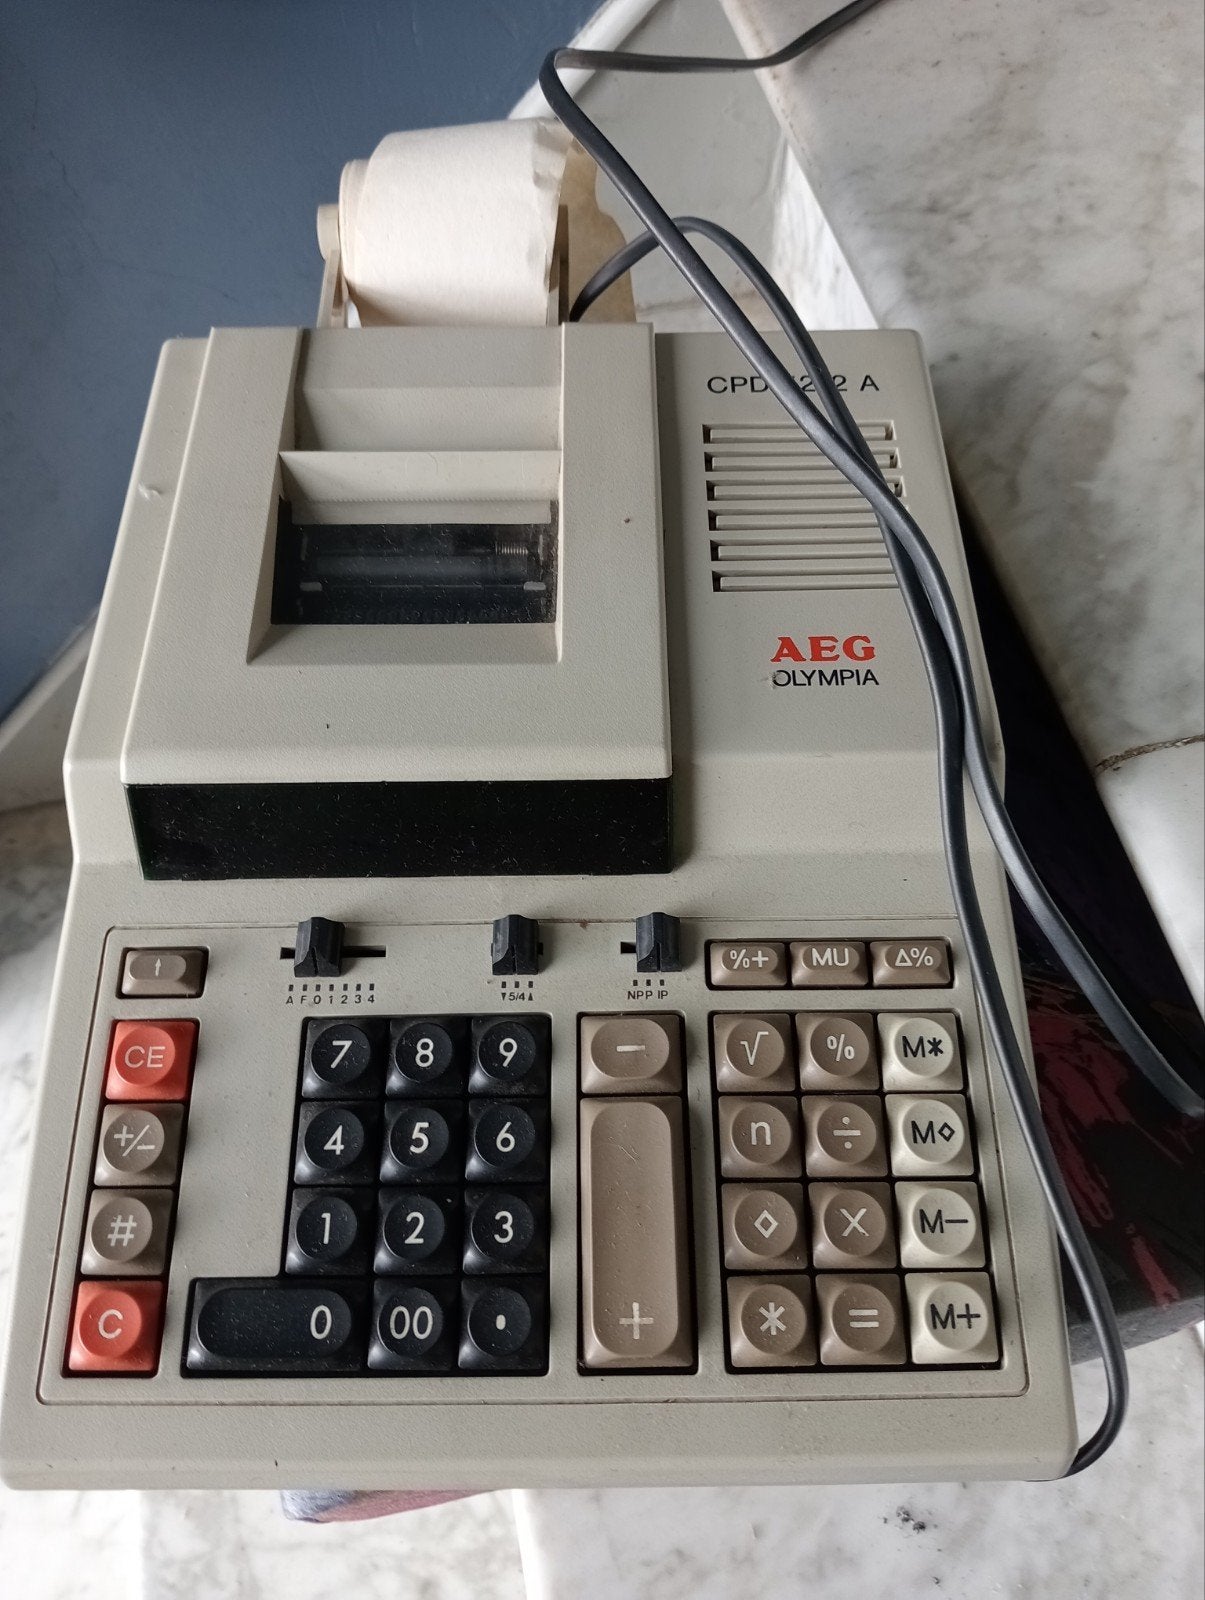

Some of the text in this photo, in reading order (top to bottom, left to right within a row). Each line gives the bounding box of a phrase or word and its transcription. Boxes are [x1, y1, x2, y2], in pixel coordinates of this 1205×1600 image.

[707, 376, 769, 393] CPD
[859, 374, 880, 392] A
[770, 635, 876, 662] AEG
[772, 669, 880, 687] OLYMPIA
[811, 947, 850, 967] MU
[340, 994, 349, 1004] 2
[354, 994, 362, 1004] 3
[367, 994, 375, 1004] 4
[124, 1045, 166, 1068] CE
[330, 1039, 353, 1069] 7
[415, 1037, 435, 1068] 8
[499, 1037, 518, 1067] 9
[323, 1124, 345, 1156] 4
[409, 1121, 430, 1154] 5
[495, 1120, 516, 1153] 6
[750, 1120, 772, 1146] n
[320, 1212, 332, 1245] 1
[404, 1211, 425, 1245] 2
[493, 1210, 514, 1244] 3
[98, 1308, 124, 1339] C
[309, 1304, 333, 1340] 0
[389, 1305, 434, 1340] 00
